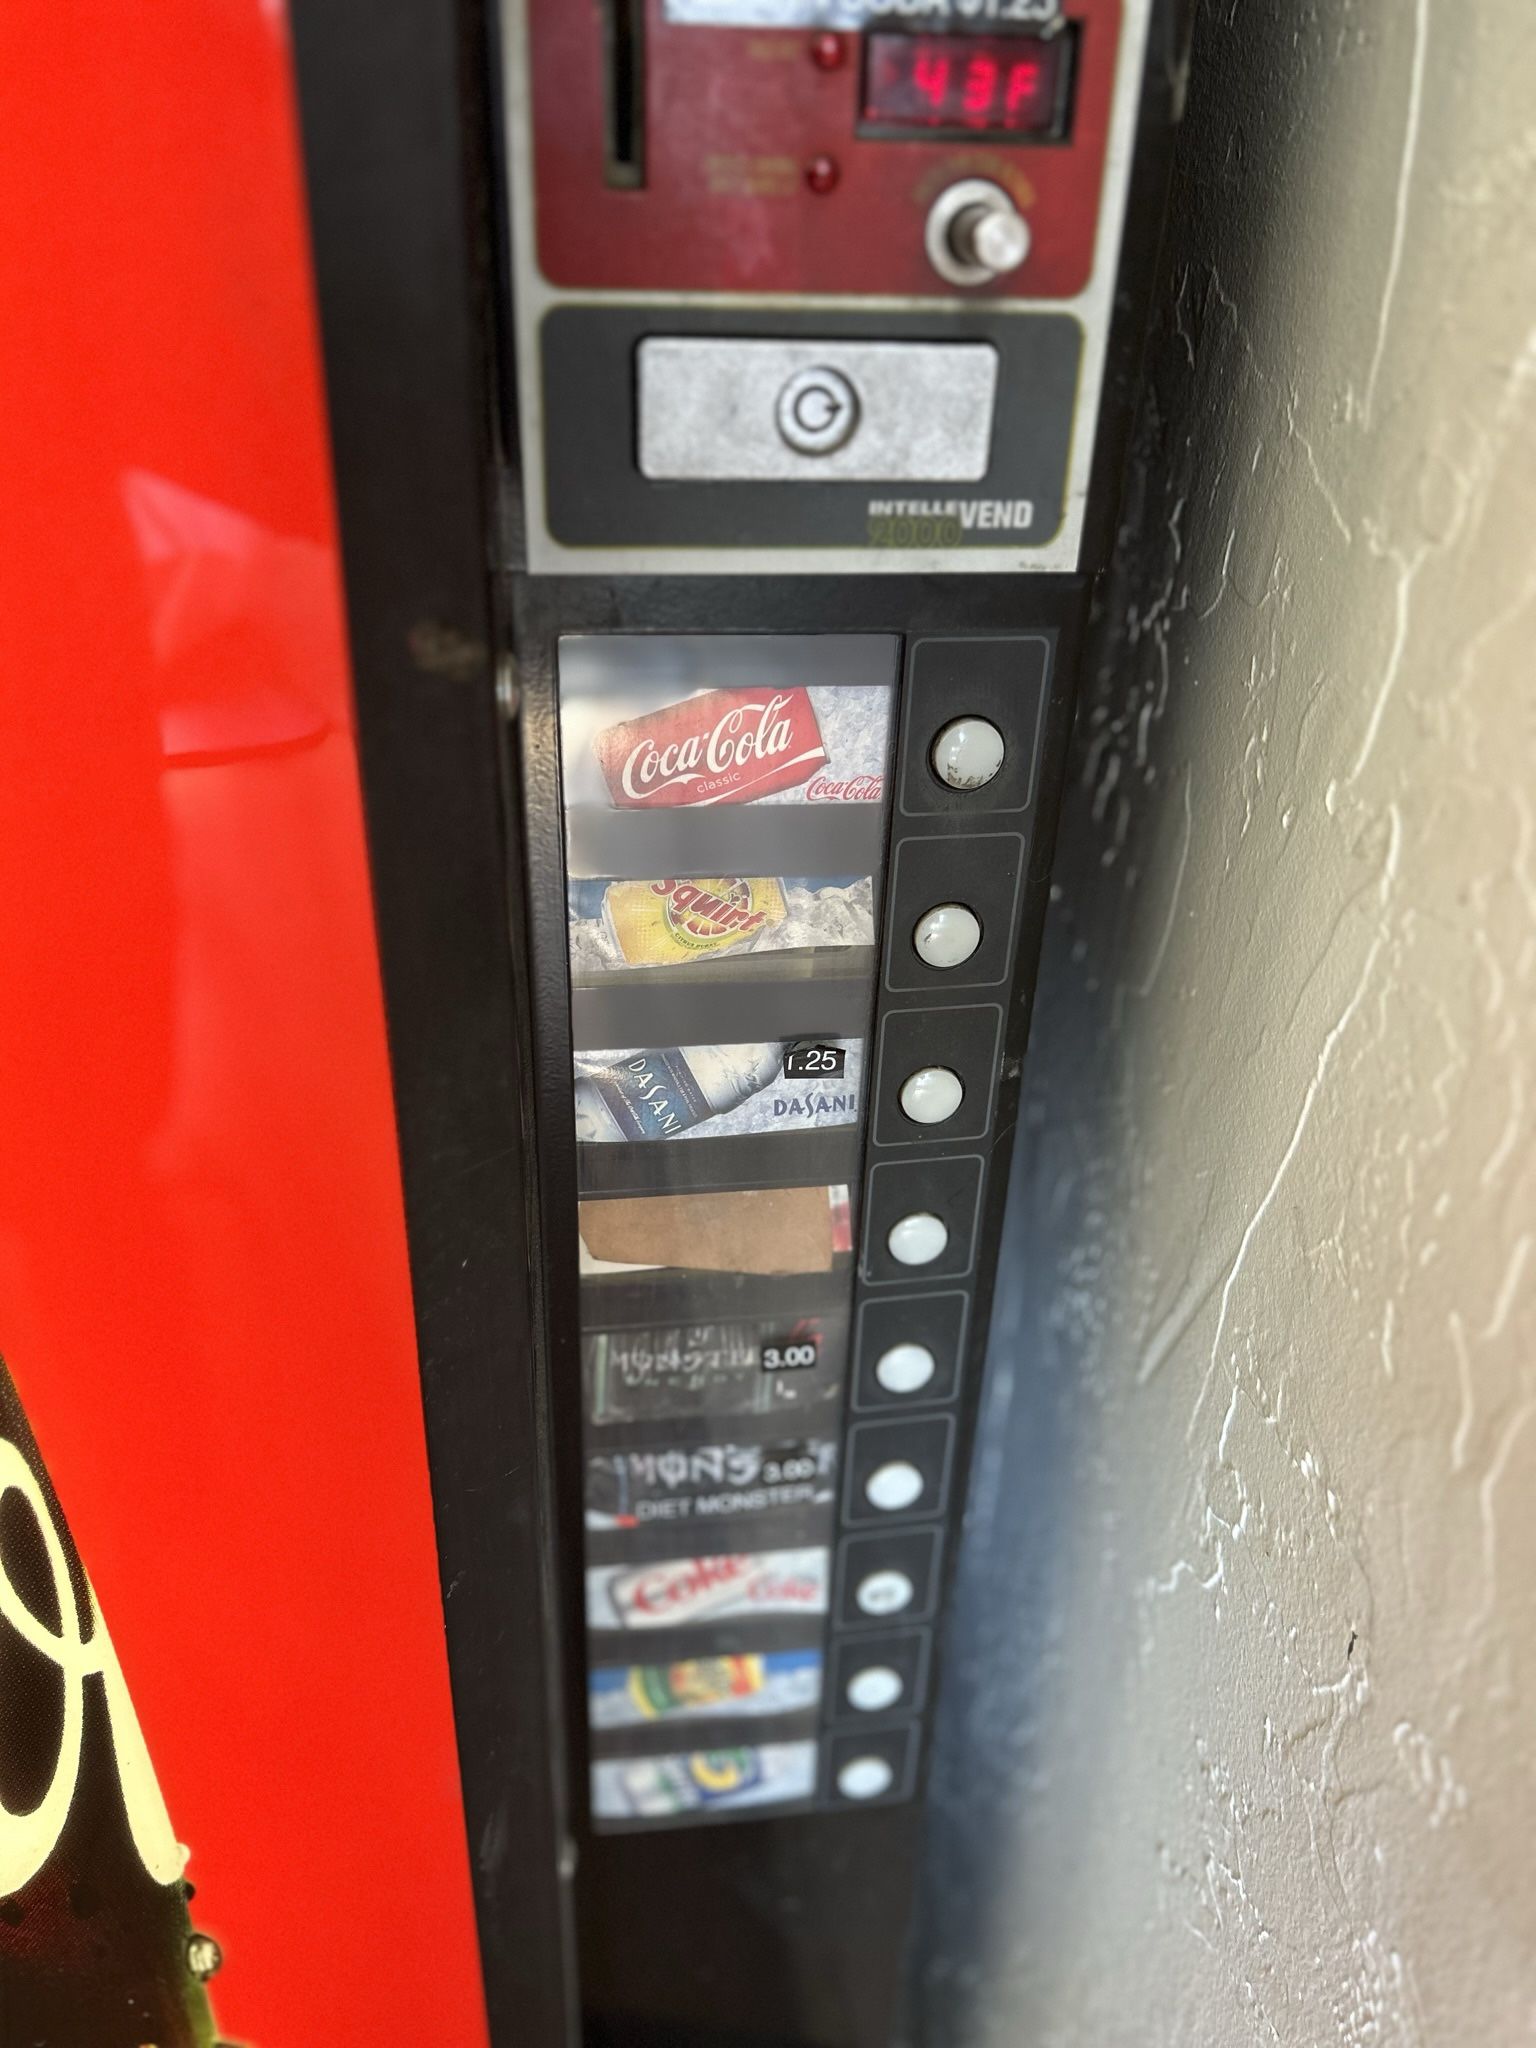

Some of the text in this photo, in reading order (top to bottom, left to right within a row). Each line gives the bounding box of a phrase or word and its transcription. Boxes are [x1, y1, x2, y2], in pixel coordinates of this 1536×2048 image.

[622, 694, 794, 799] Coca-Cola
[696, 771, 741, 793] classic
[806, 775, 883, 801] Coca-Cola
[787, 1050, 837, 1071] 1.25
[628, 1058, 682, 1135] DASANI
[774, 1092, 856, 1118] DASANI
[763, 1345, 815, 1370] 3.00
